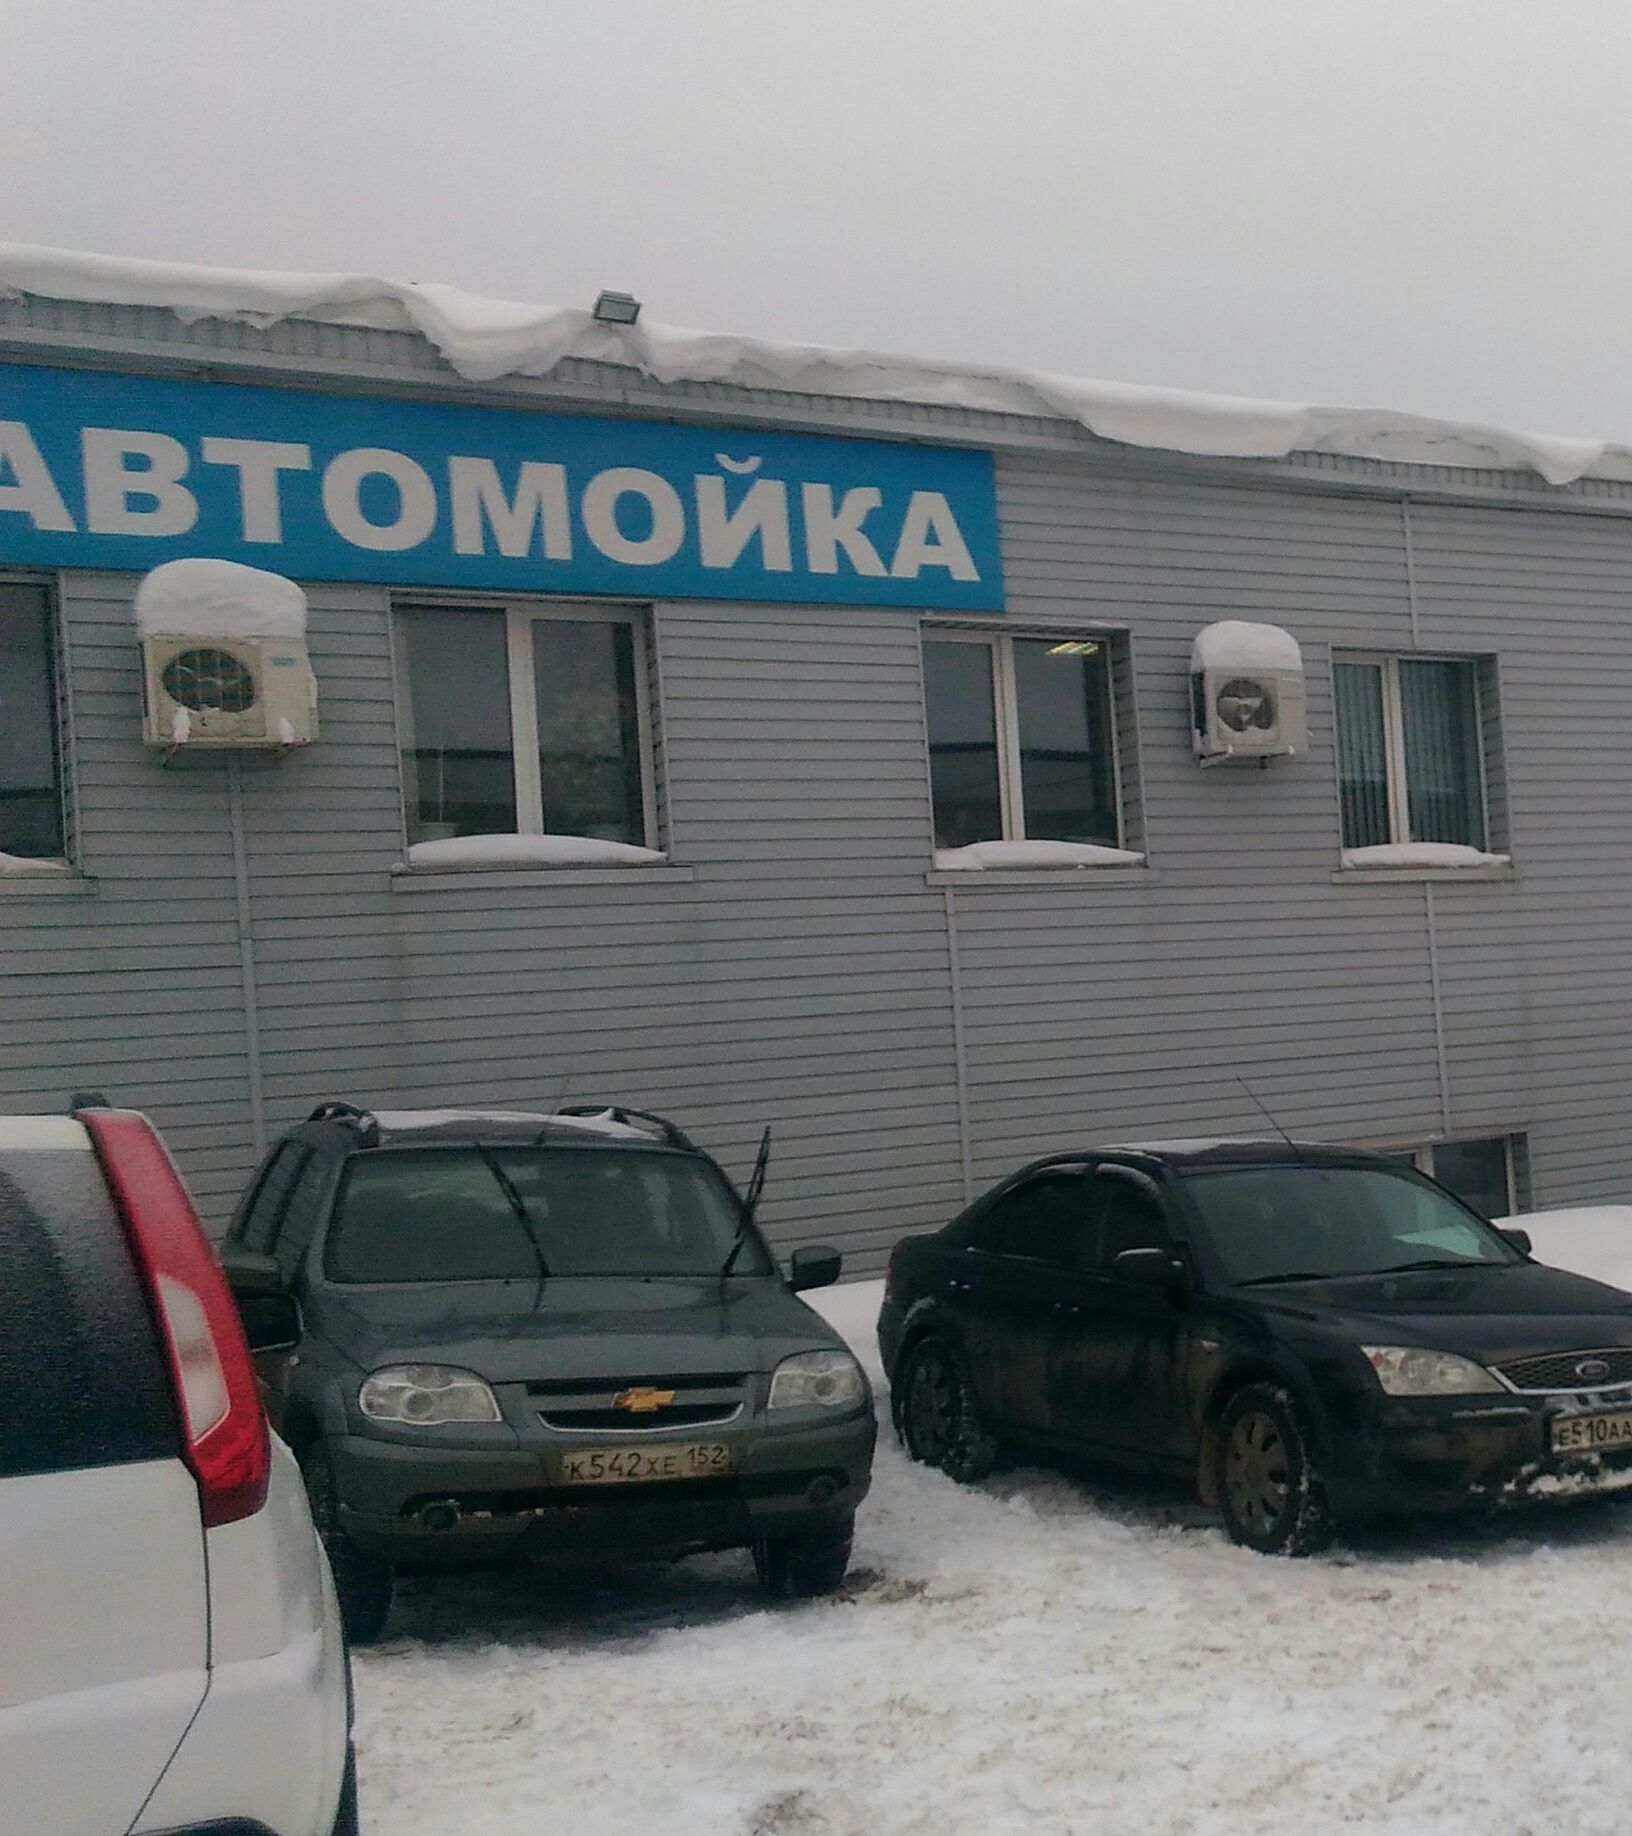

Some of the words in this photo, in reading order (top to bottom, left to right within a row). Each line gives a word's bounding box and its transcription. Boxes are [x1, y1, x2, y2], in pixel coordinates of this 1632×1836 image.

[0, 420, 980, 582] АВТОМОЙКА
[569, 1452, 677, 1480] К542ХЕ
[687, 1445, 724, 1465] 152
